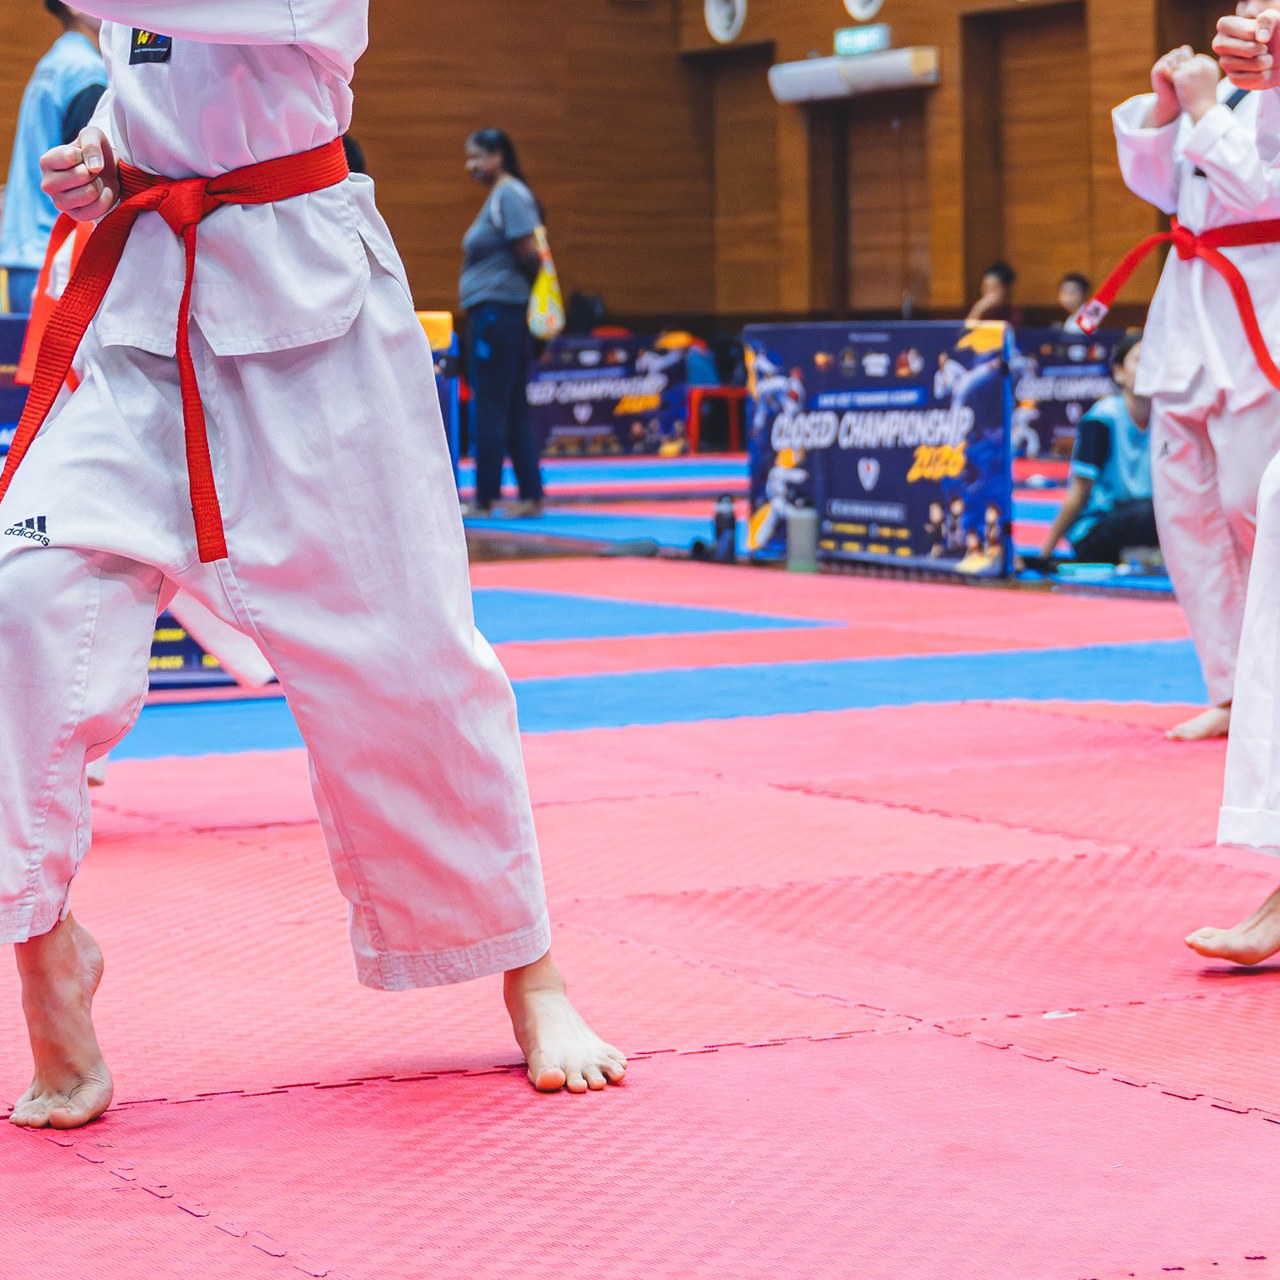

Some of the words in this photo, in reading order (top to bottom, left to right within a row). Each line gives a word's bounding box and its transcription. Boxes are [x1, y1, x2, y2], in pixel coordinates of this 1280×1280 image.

[771, 410, 838, 452] CLOSED
[838, 405, 975, 451] CHAMPIONSHIP
[4, 527, 51, 547] adidas
